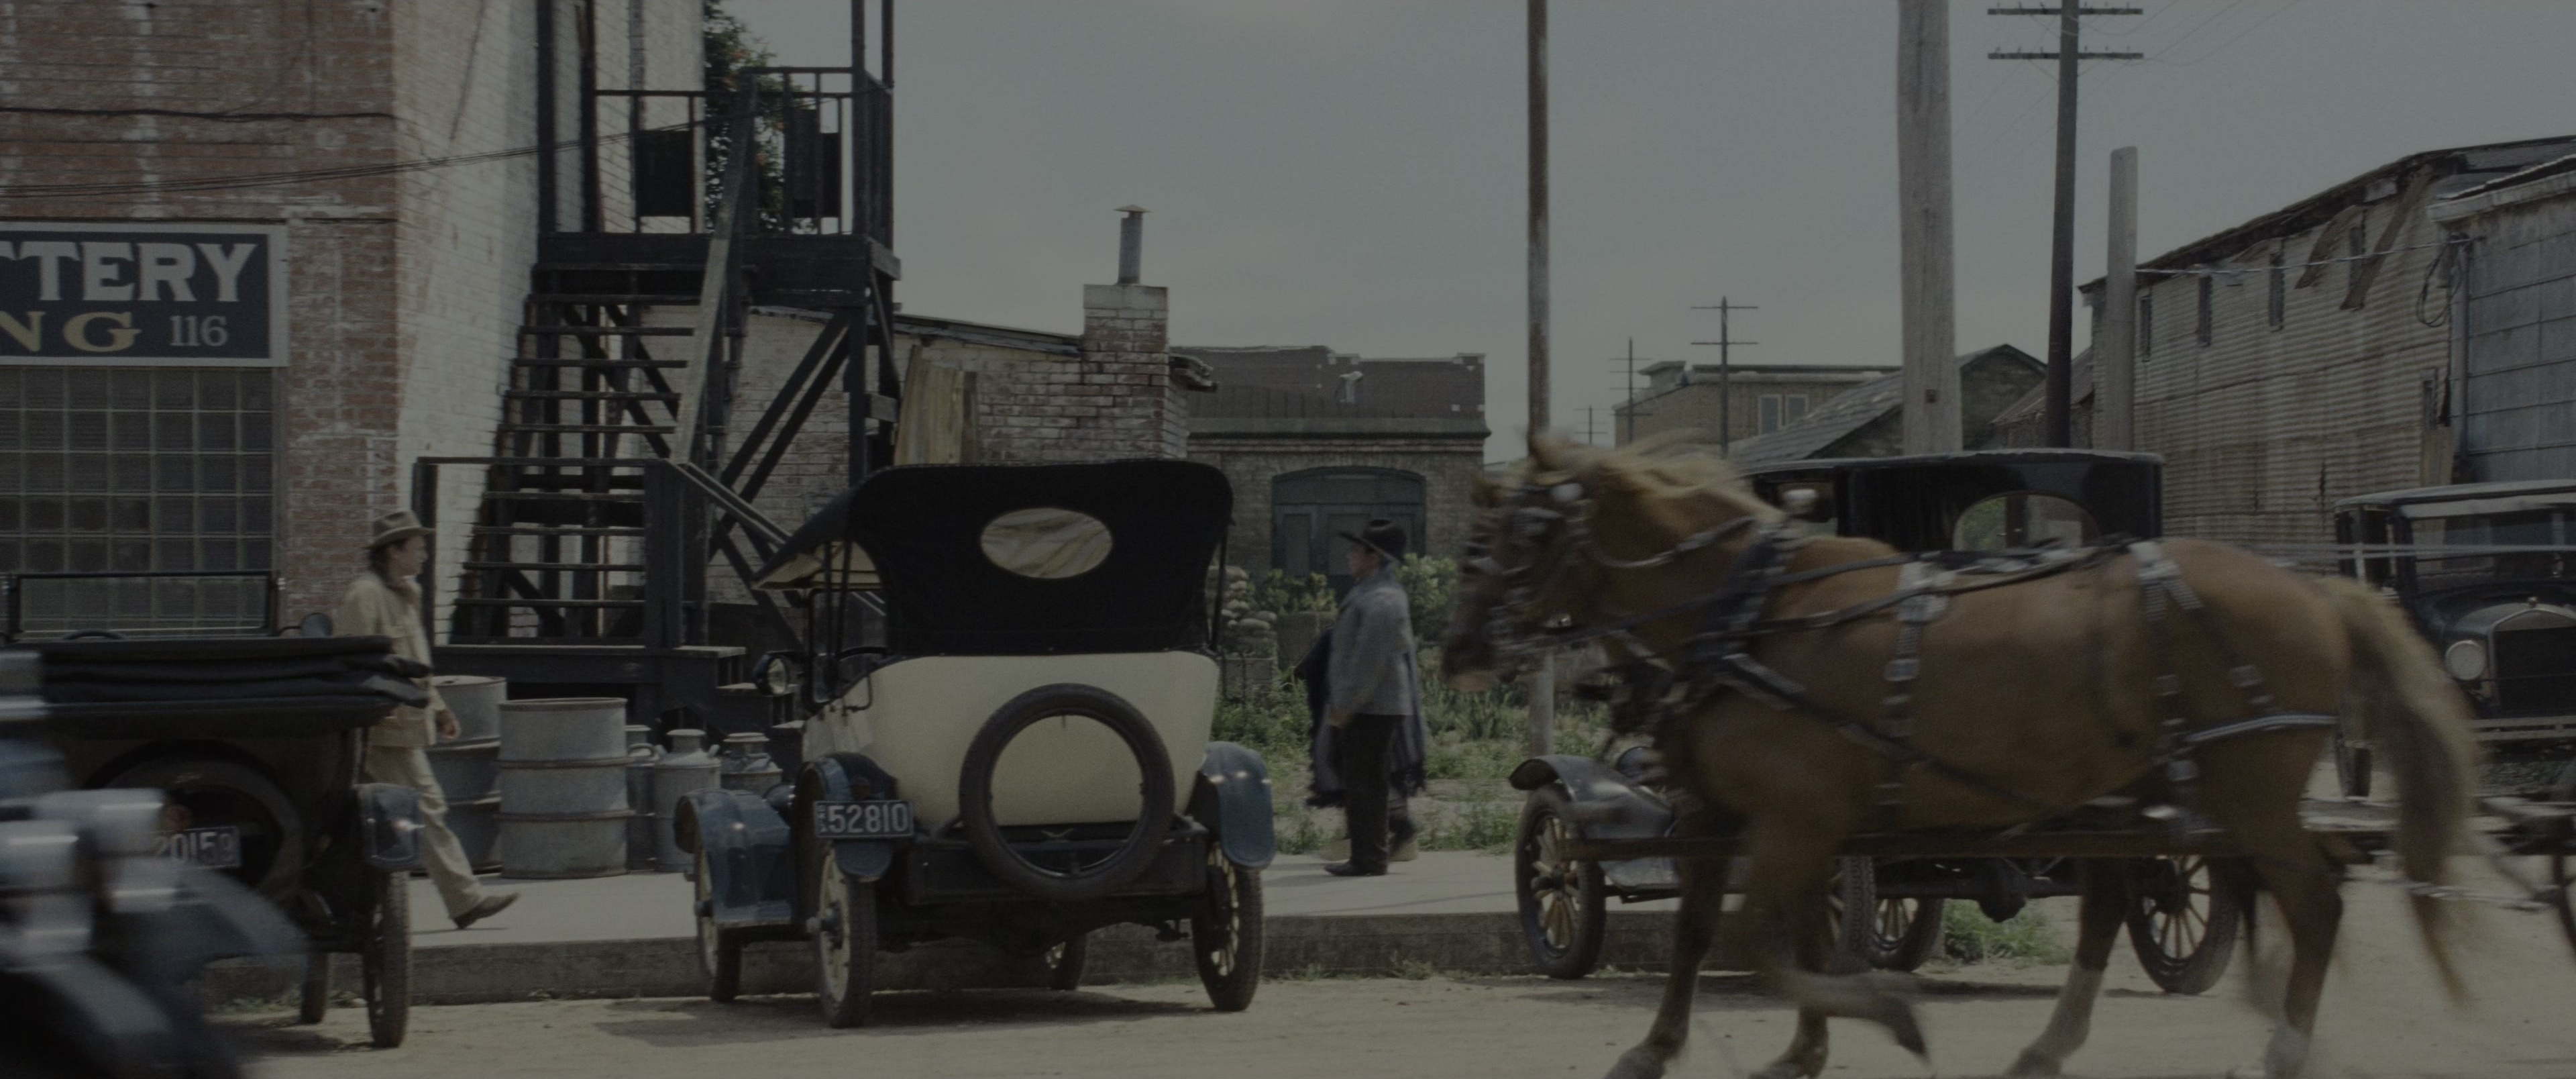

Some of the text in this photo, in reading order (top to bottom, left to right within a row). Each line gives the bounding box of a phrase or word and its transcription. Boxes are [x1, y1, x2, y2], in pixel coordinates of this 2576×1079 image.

[0, 241, 258, 302] TERY
[170, 315, 227, 346] 116
[828, 804, 908, 833] 52810
